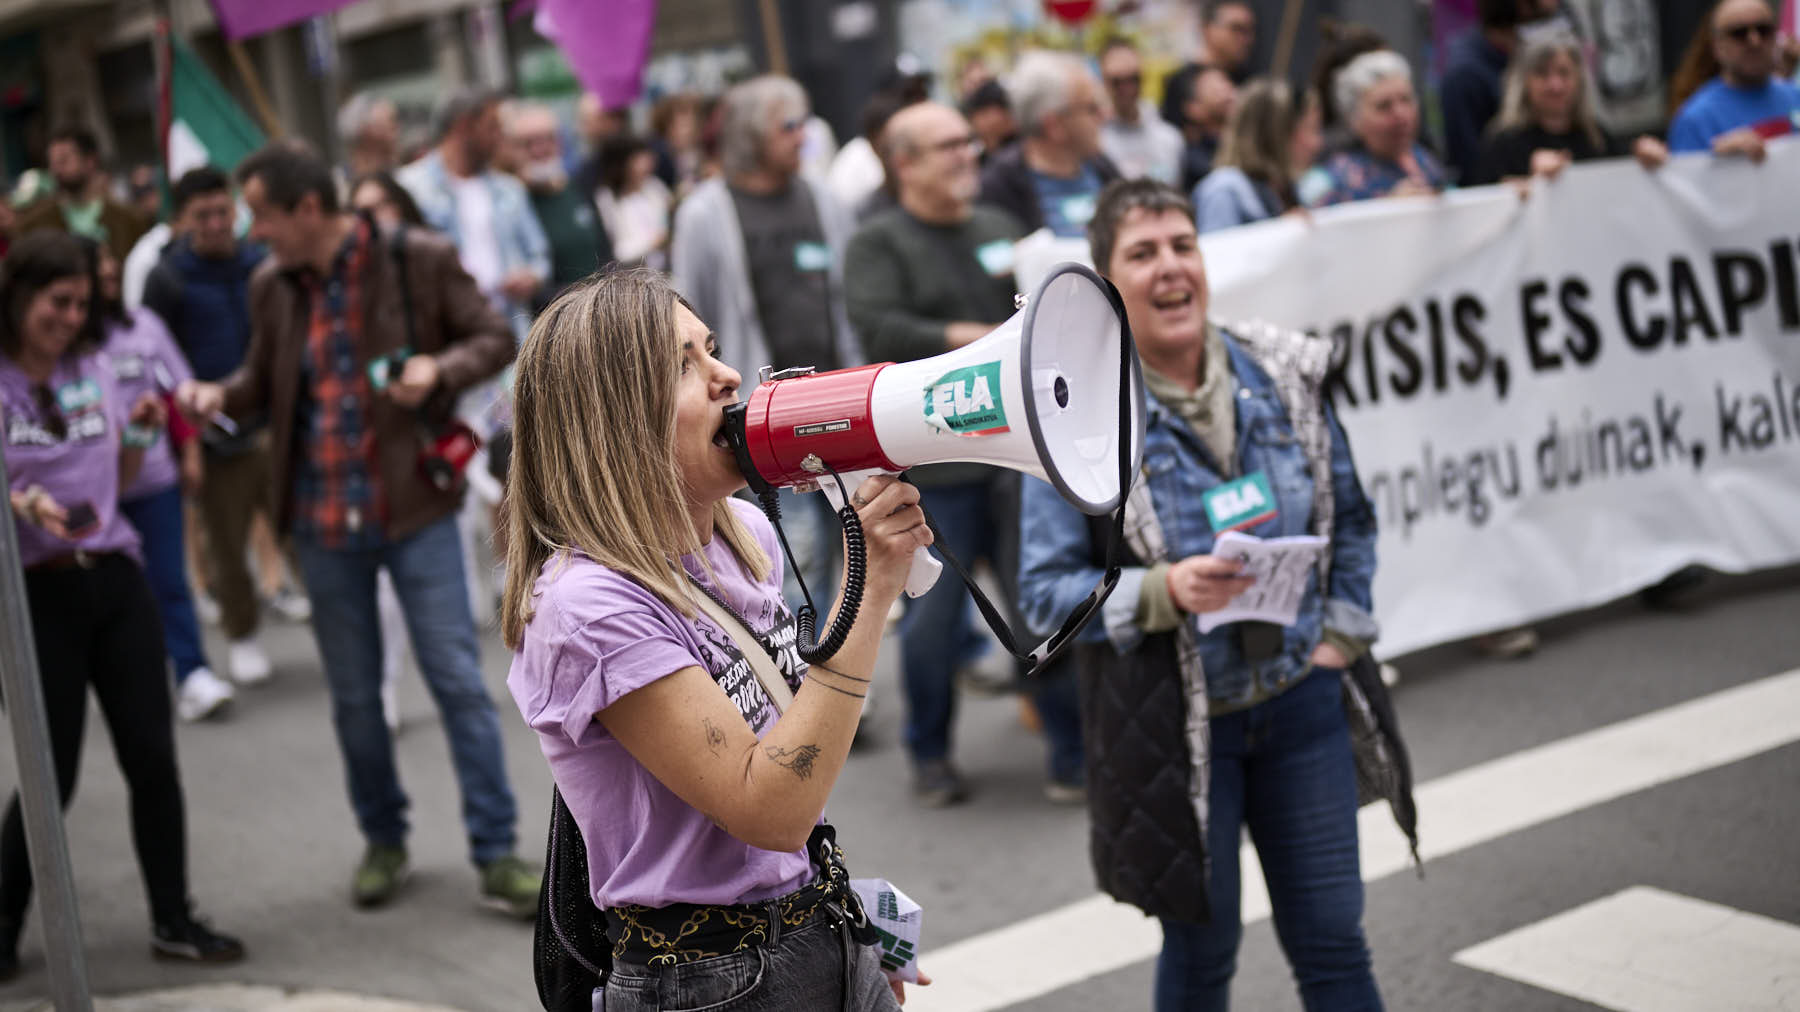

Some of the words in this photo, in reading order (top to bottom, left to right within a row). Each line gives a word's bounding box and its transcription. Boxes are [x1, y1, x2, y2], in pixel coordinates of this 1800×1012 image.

[933, 375, 995, 418] ELA
[1322, 295, 1510, 407] RISIS,
[1520, 276, 1602, 373] ES
[1615, 236, 1800, 354] CAPI
[1370, 437, 1521, 541] nplegu
[1535, 391, 1706, 492] duinak,
